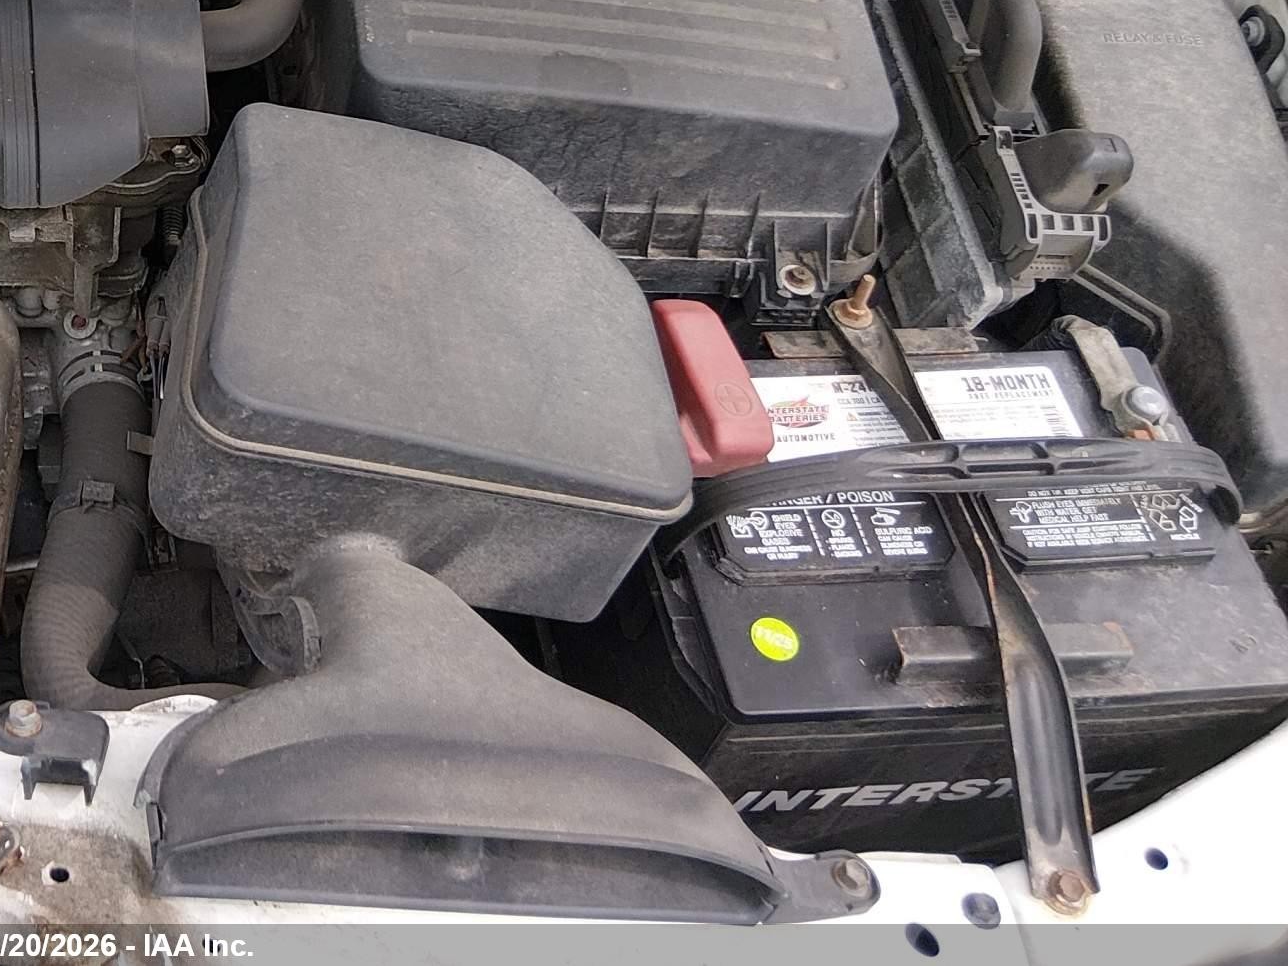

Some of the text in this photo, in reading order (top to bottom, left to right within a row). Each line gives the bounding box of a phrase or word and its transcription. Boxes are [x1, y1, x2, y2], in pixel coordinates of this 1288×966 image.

[1103, 33, 1148, 43] RELAY
[1166, 33, 1202, 46] FUSE
[962, 373, 1051, 392] 18-MONTH
[767, 404, 830, 414] NTERSTATE
[776, 432, 836, 443] AUTOMOTIVE
[837, 491, 896, 503] POISON
[734, 768, 1156, 812] INTERSTTE
